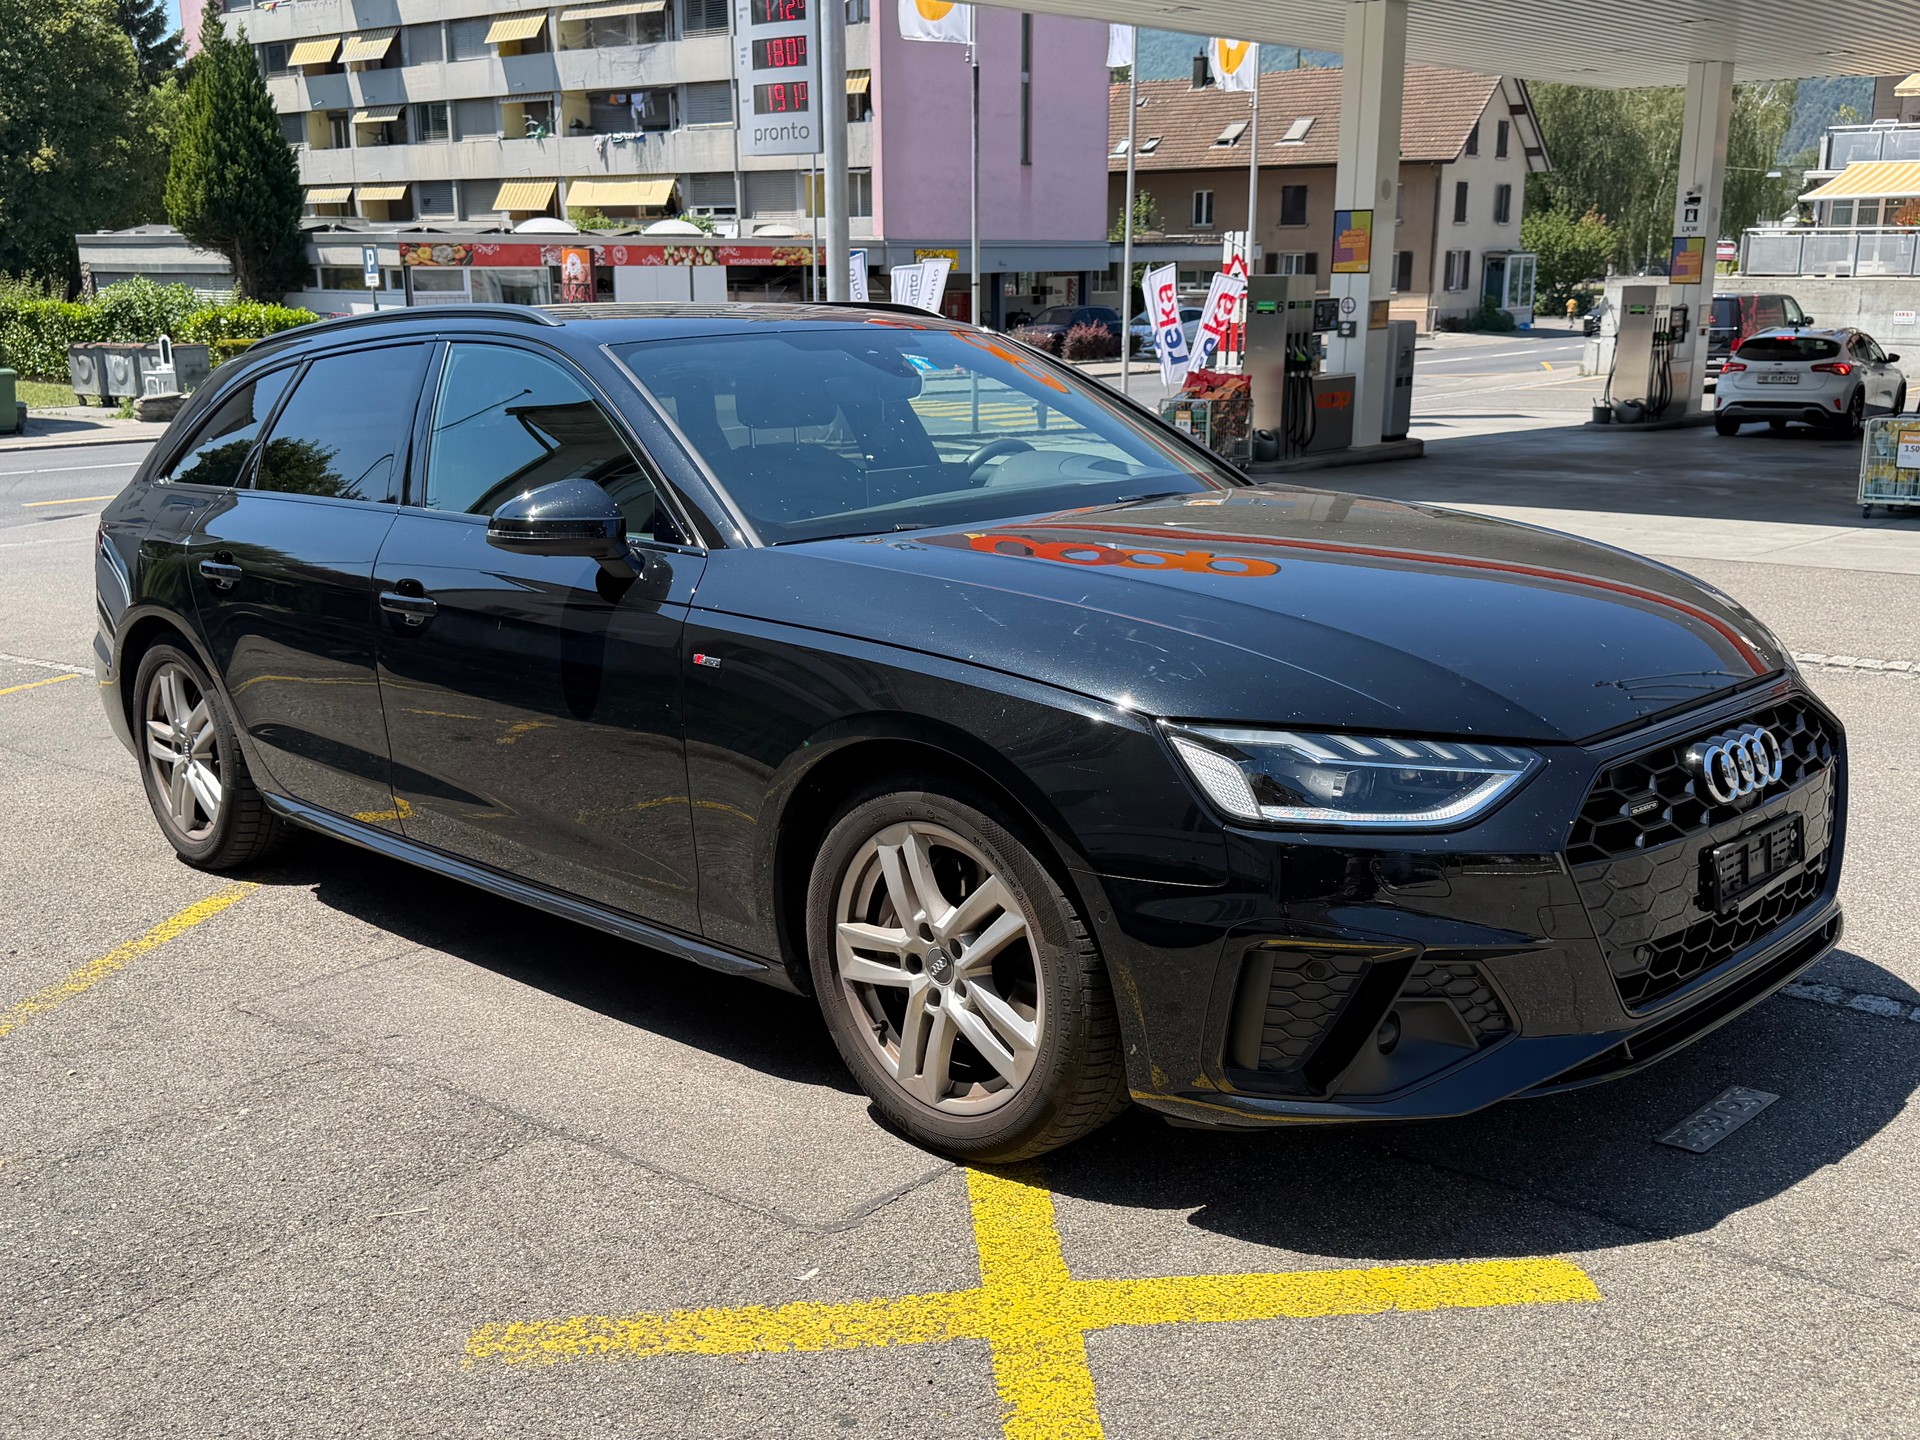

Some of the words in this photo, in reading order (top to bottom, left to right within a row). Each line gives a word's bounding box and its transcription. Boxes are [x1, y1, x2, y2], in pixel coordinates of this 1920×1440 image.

[754, 122, 810, 146] pronto
[366, 249, 375, 272] P
[1277, 301, 1284, 313] 6
[1647, 305, 1653, 314] 2
[1159, 283, 1189, 365] reka
[1316, 391, 1348, 409] coop
